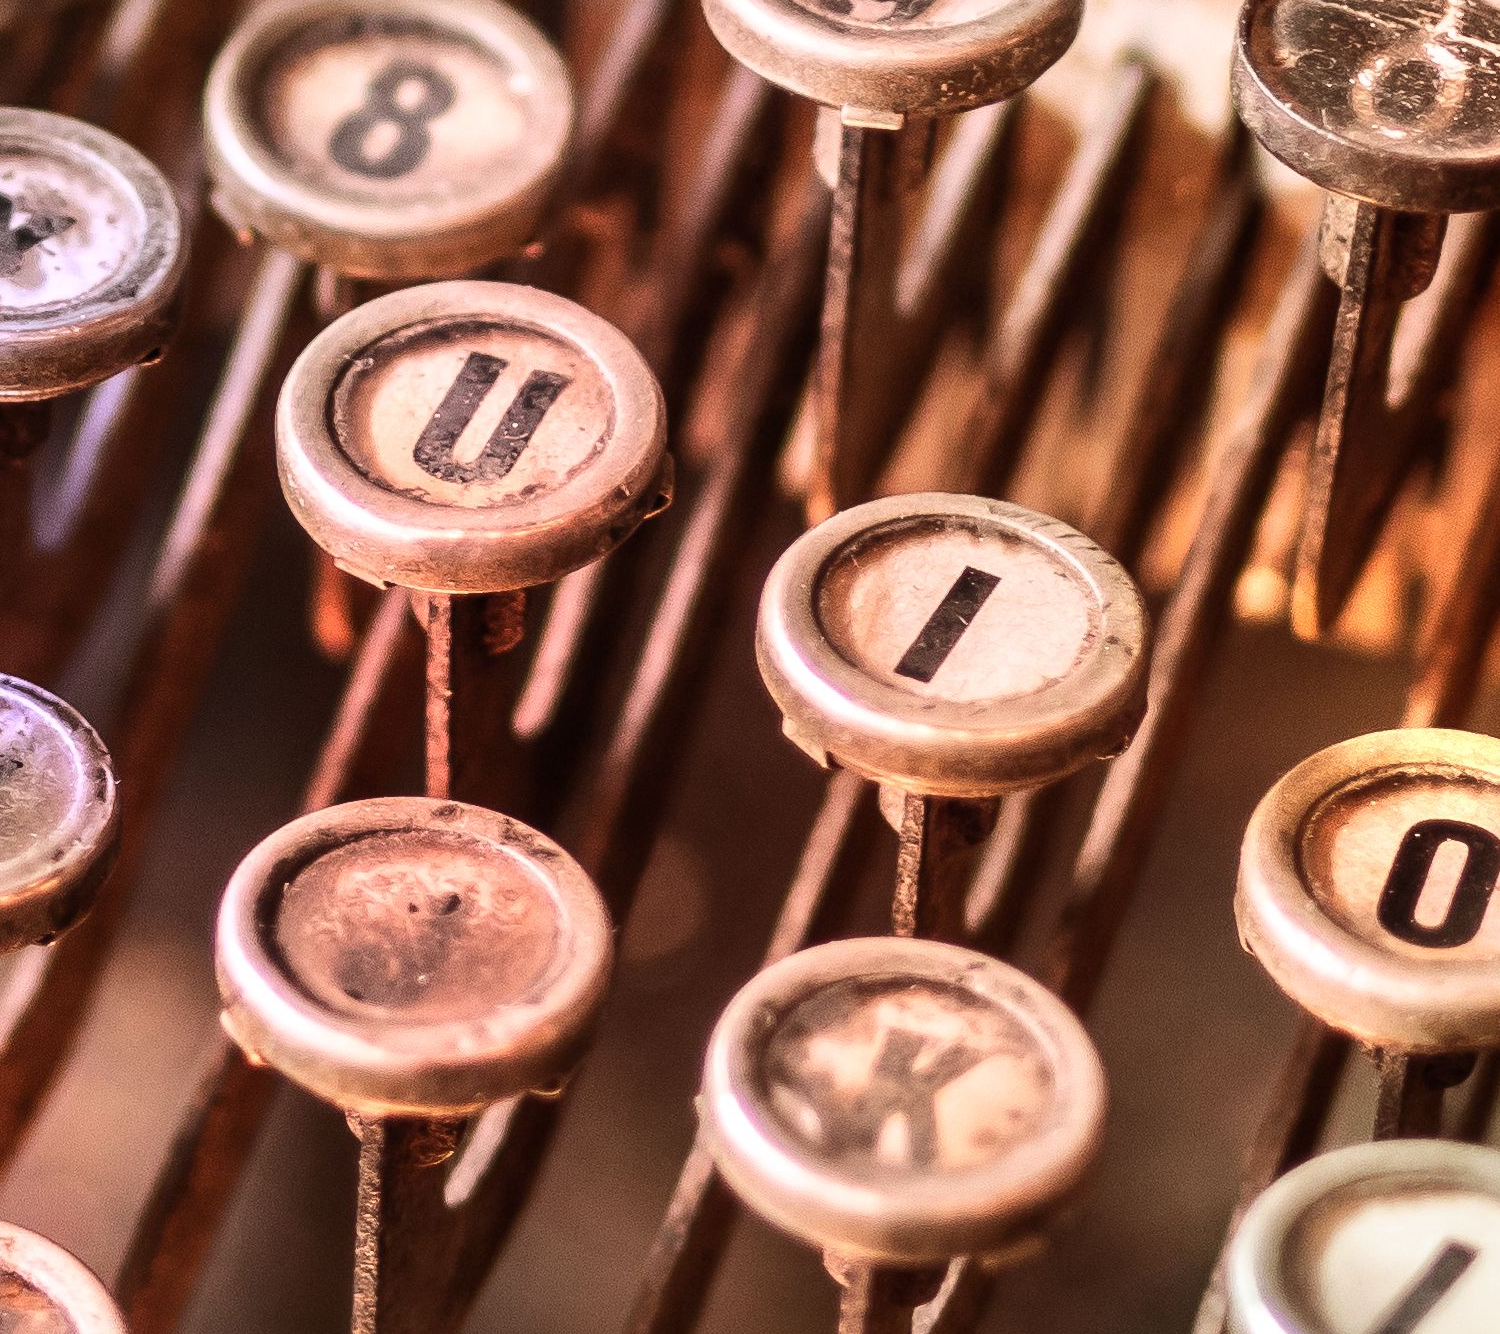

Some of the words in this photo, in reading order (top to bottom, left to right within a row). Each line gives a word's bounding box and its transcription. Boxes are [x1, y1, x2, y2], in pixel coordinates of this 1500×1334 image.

[328, 59, 456, 181] 8
[410, 351, 570, 487] U
[892, 563, 1002, 685] I
